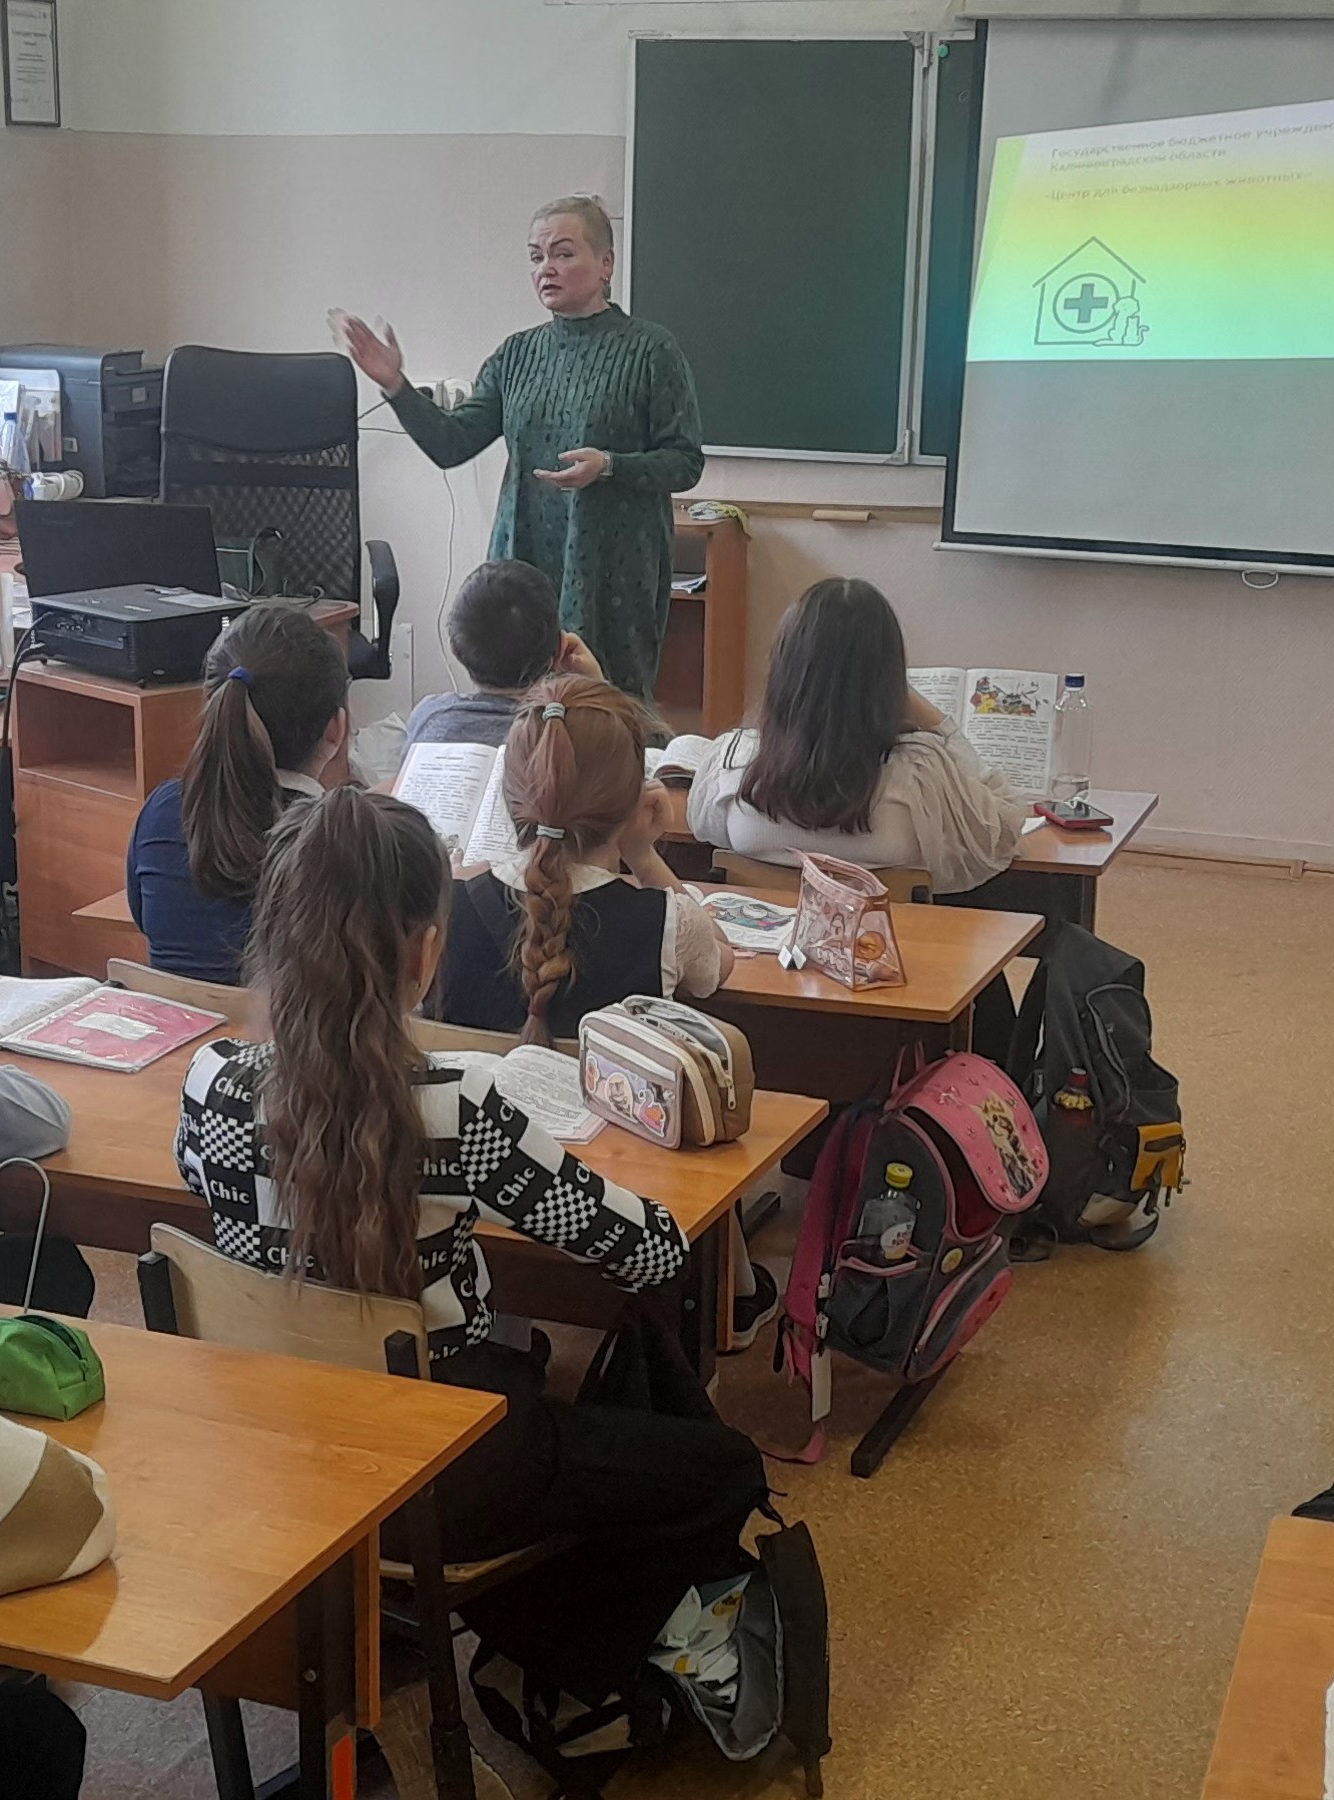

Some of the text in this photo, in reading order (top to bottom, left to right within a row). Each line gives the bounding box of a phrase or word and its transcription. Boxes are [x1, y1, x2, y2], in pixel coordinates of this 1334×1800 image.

[214, 1076, 254, 1103] Chic
[417, 1158, 462, 1176] hic
[209, 1179, 250, 1204] Chic
[496, 1167, 536, 1206] Chic
[585, 1222, 626, 1259] Chic
